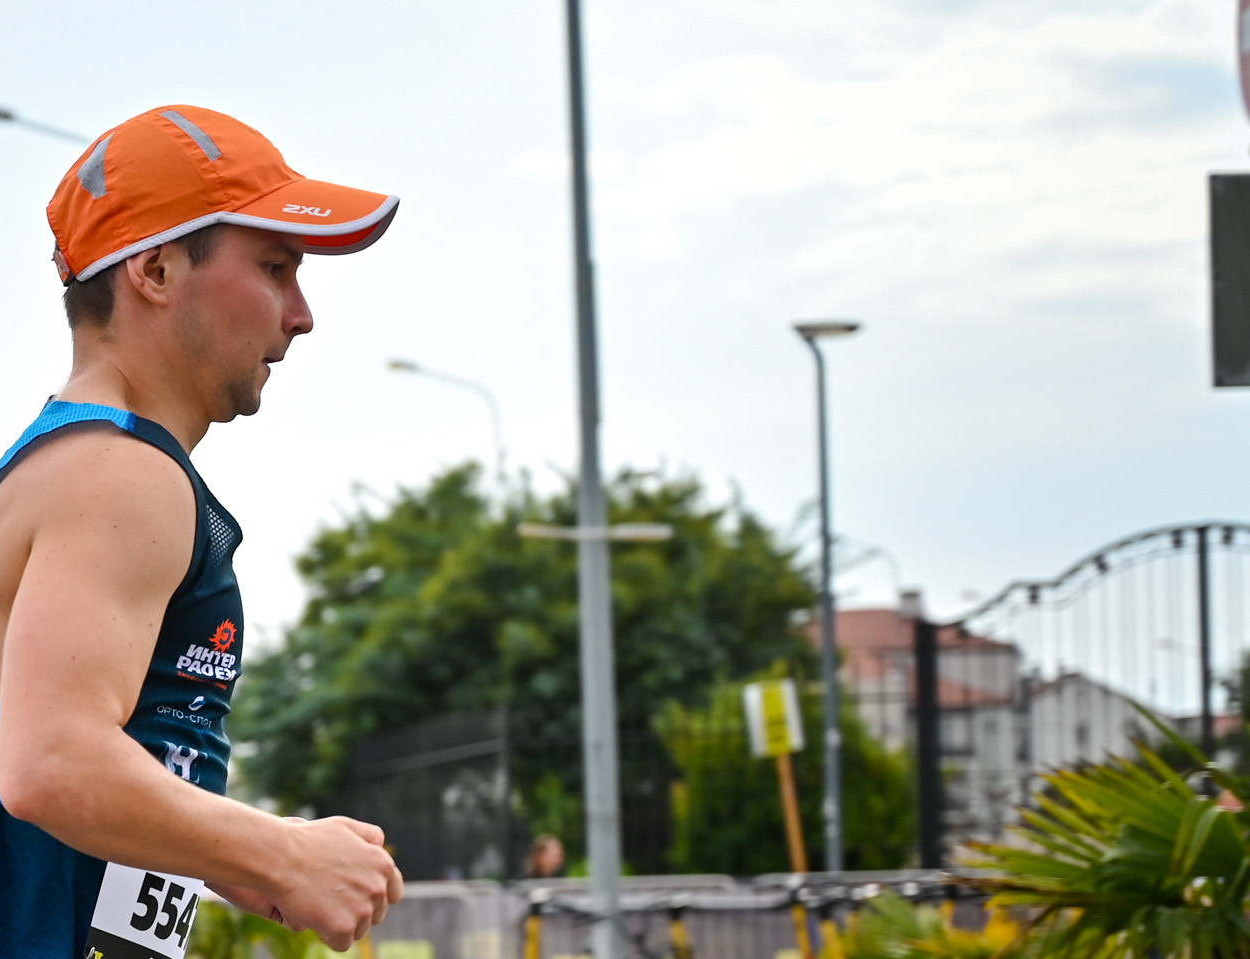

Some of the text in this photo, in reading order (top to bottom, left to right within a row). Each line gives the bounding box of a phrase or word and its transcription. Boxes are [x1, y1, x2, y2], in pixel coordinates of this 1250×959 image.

[282, 203, 332, 217] 2XU
[186, 644, 236, 668] ИНТЕР
[130, 871, 200, 951] 554
